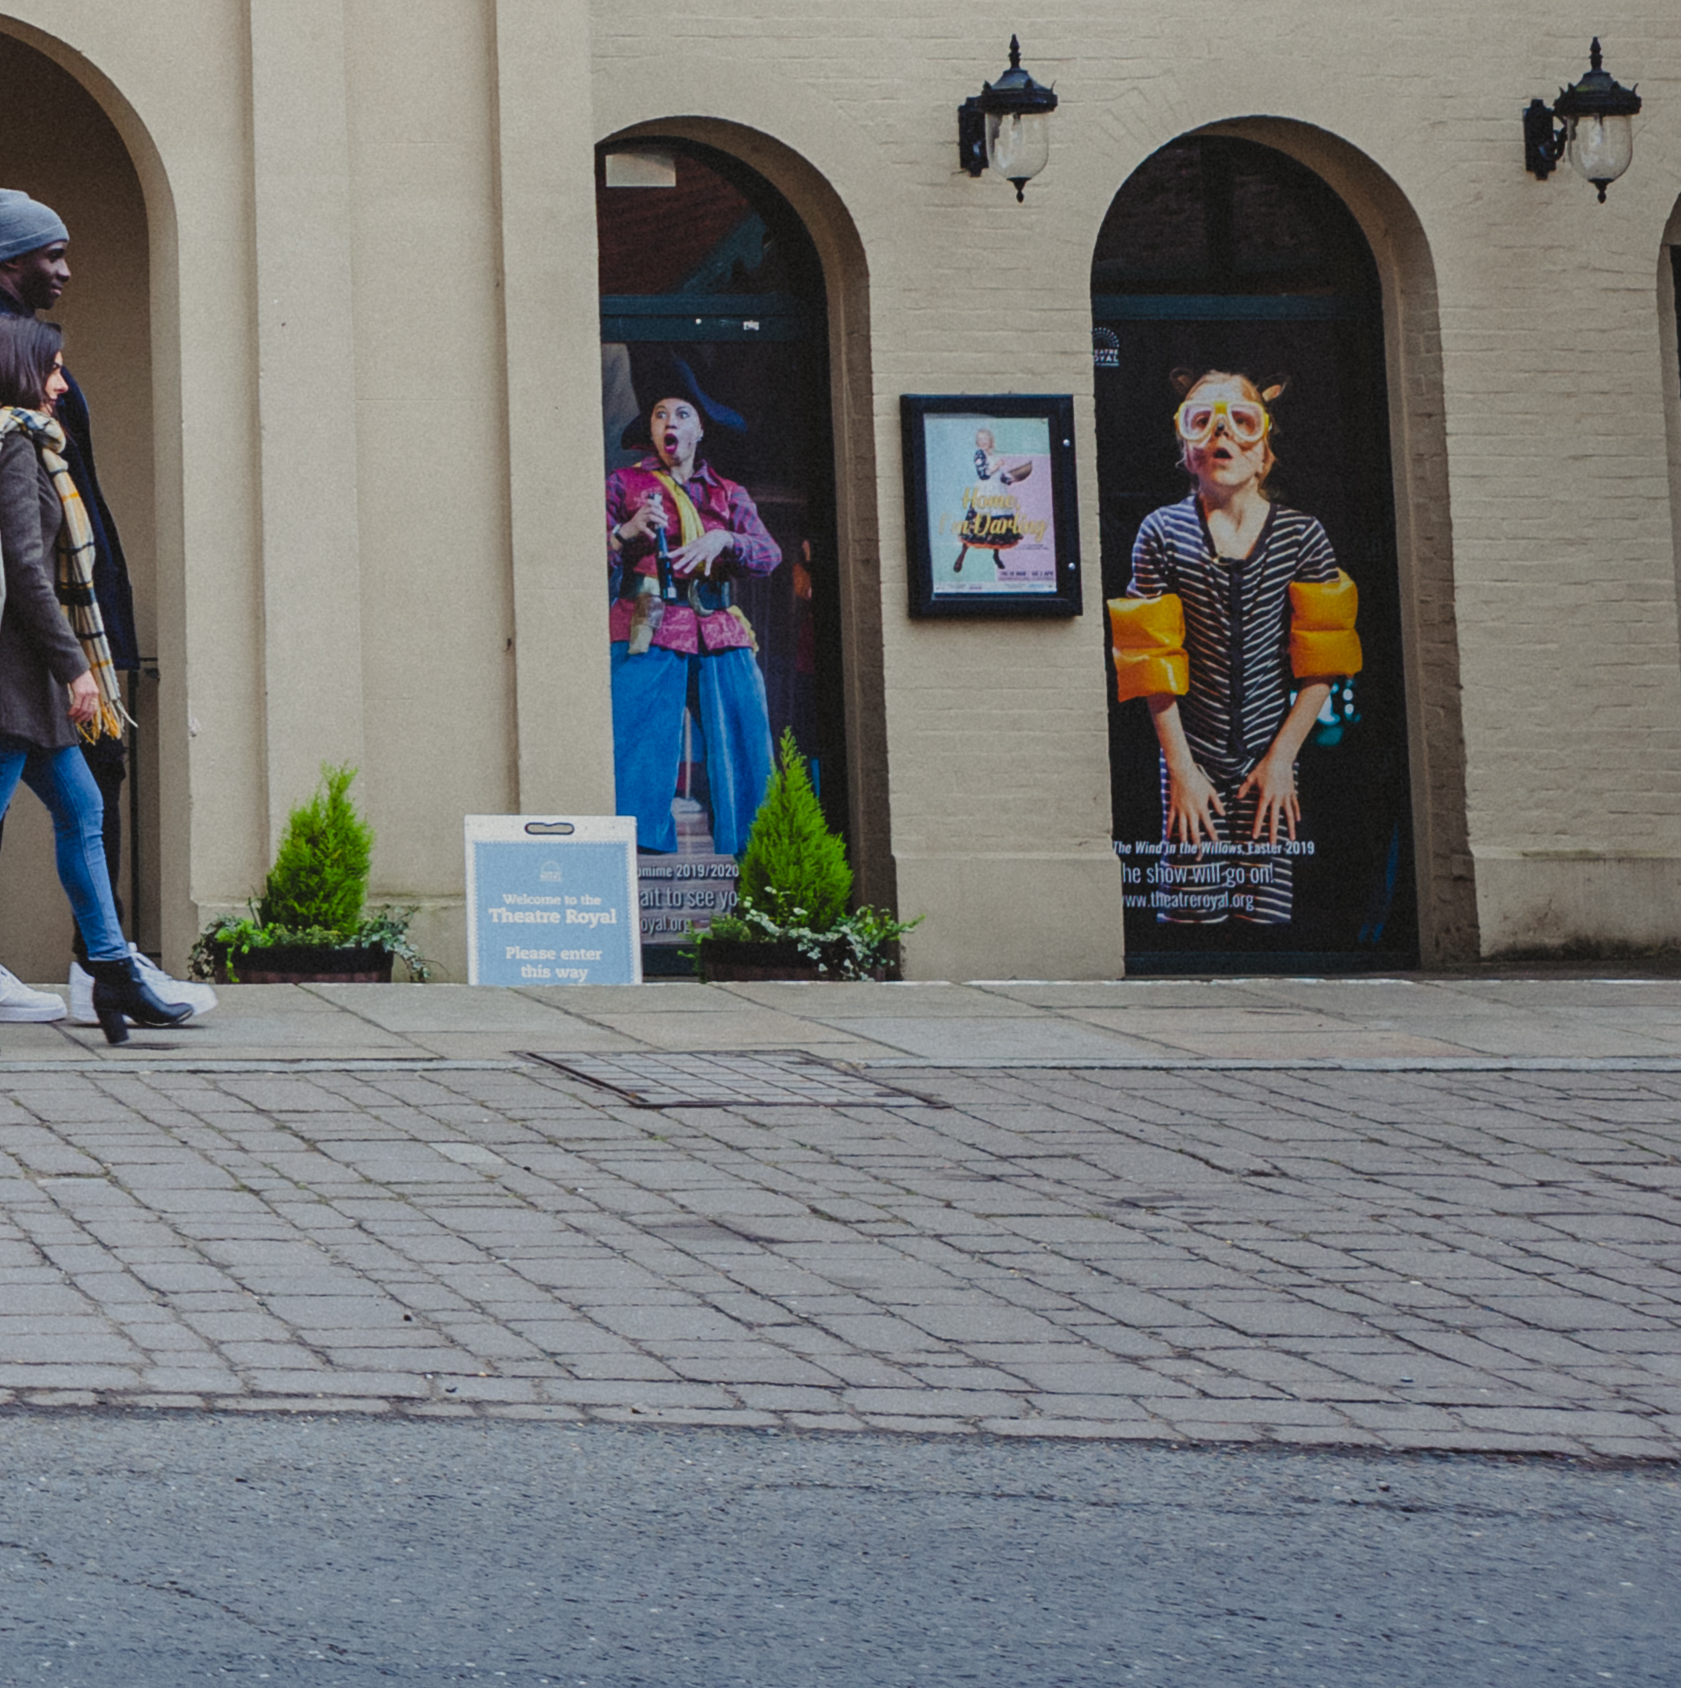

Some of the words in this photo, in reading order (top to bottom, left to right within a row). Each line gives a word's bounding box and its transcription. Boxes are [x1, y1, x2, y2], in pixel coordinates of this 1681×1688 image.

[962, 486, 1021, 509] Home,
[972, 511, 1048, 542] Darling
[1113, 841, 1132, 854] The
[1136, 841, 1162, 854] Wind
[1165, 841, 1176, 854] in
[1180, 841, 1197, 854] the
[1248, 841, 1282, 854] Easter
[1286, 841, 1315, 855] 2019
[638, 865, 672, 878] omime
[676, 864, 739, 877] 2019/2020
[1122, 863, 1141, 883] he
[1147, 863, 1187, 883] show
[1193, 863, 1220, 883] will
[1225, 867, 1245, 888] go
[1250, 863, 1274, 883] on!
[502, 894, 561, 905] Welcome
[565, 895, 577, 905] to
[581, 894, 602, 905] the
[640, 887, 660, 906] ait
[666, 887, 682, 906] to
[687, 891, 714, 906] see
[720, 891, 738, 911] yo
[488, 908, 561, 923] Theatre
[565, 908, 617, 928] Royal
[505, 946, 556, 960] Please
[560, 948, 603, 960] enter
[521, 964, 551, 978] this
[555, 968, 588, 982] way
